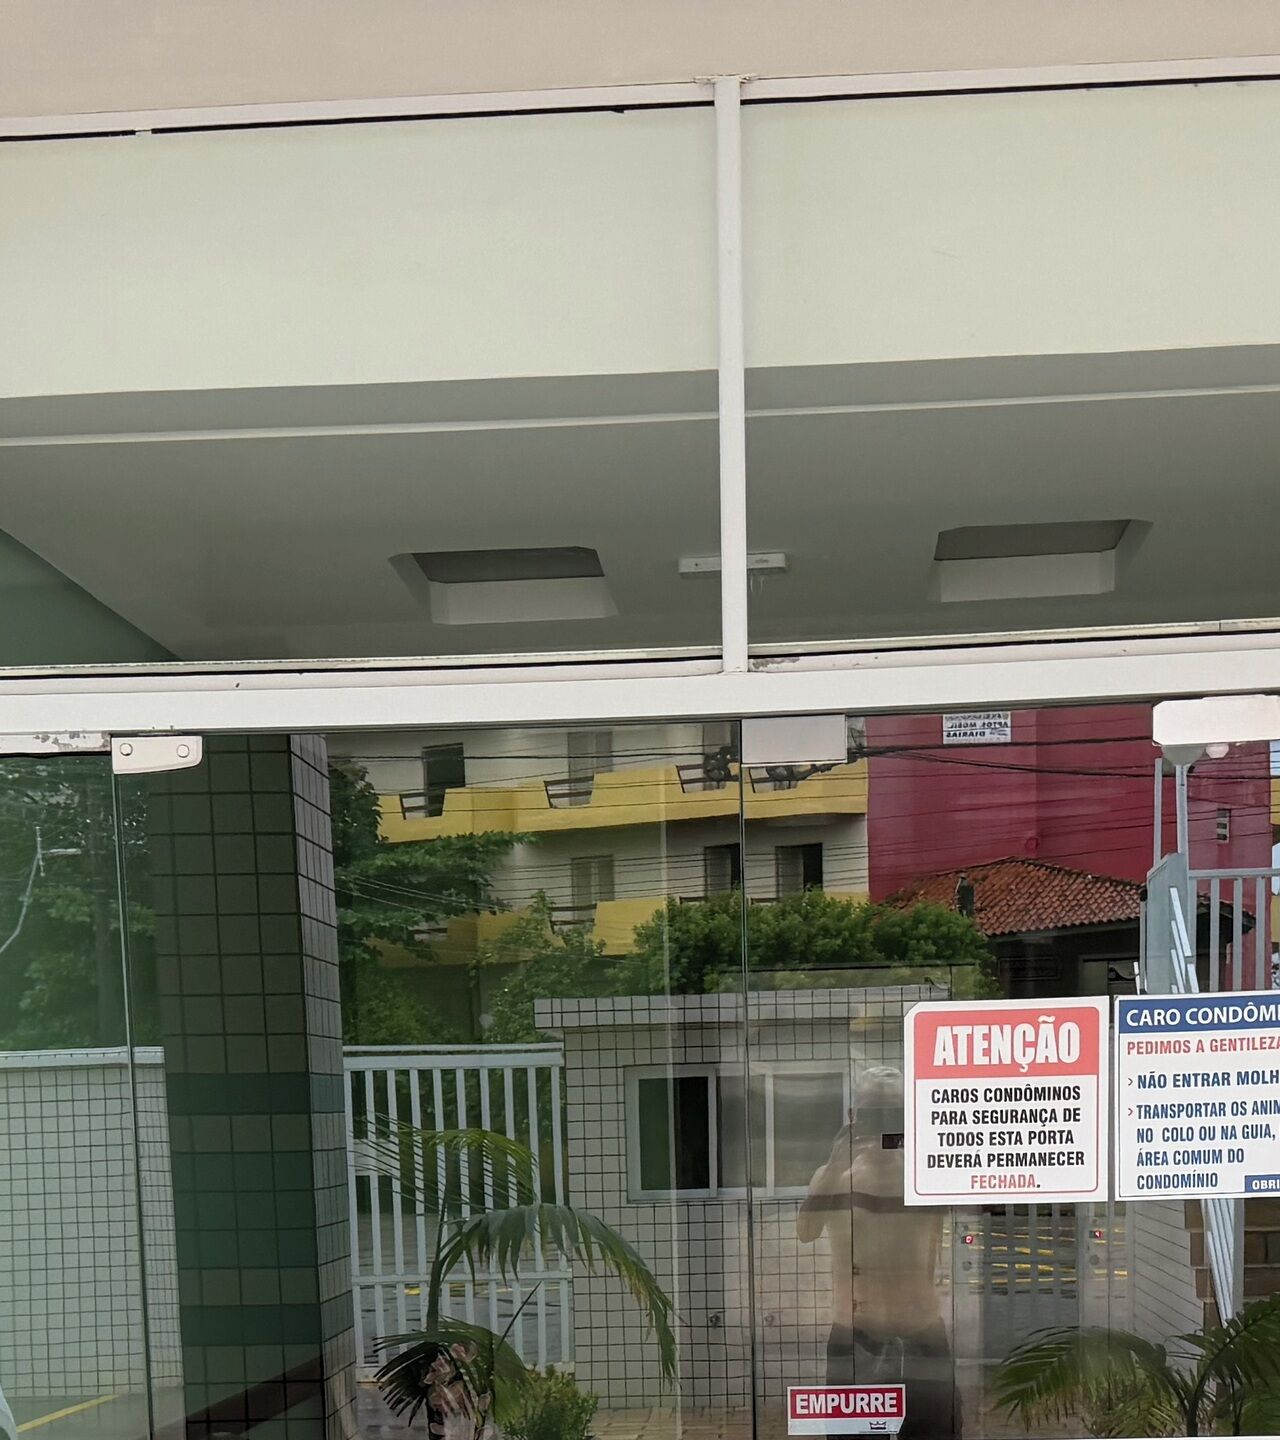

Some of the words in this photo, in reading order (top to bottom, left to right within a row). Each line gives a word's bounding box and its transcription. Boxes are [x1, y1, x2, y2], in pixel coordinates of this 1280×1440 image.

[1126, 1008, 1181, 1027] CARO
[933, 1014, 1081, 1073] ATENÇÃO
[1127, 1039, 1191, 1056] PEDIMOS
[1195, 1039, 1205, 1053] A
[1137, 1071, 1167, 1089] NÃO
[1172, 1072, 1231, 1088] ENTRAR
[931, 1088, 979, 1104] CAROS
[983, 1084, 1081, 1103] CONDÔMINOS
[931, 1110, 968, 1126] PARA
[972, 1108, 1058, 1127] SEGURANÇA
[1063, 1107, 1081, 1122] DE
[1136, 1102, 1227, 1120] TRANSPORTAR
[1230, 1100, 1247, 1117] OS
[937, 1132, 984, 1147] TODOS
[989, 1131, 1023, 1146] ESTA
[1028, 1129, 1074, 1145] PORTA
[1136, 1127, 1154, 1143] NO
[1162, 1126, 1195, 1143] COLO
[1198, 1125, 1216, 1142] OU
[1220, 1124, 1238, 1141] NA
[1242, 1123, 1276, 1141] GUIA,
[927, 1150, 982, 1169] DEVERÁ
[987, 1151, 1085, 1168] PERMANECER
[1136, 1148, 1169, 1167] ÁREA
[1173, 1149, 1223, 1166] COMUM
[1227, 1148, 1245, 1163] DO
[971, 1174, 1041, 1189] FECHADA.
[1136, 1170, 1219, 1190] CONDOMÍNIO
[795, 1392, 898, 1415] EMPURRE
